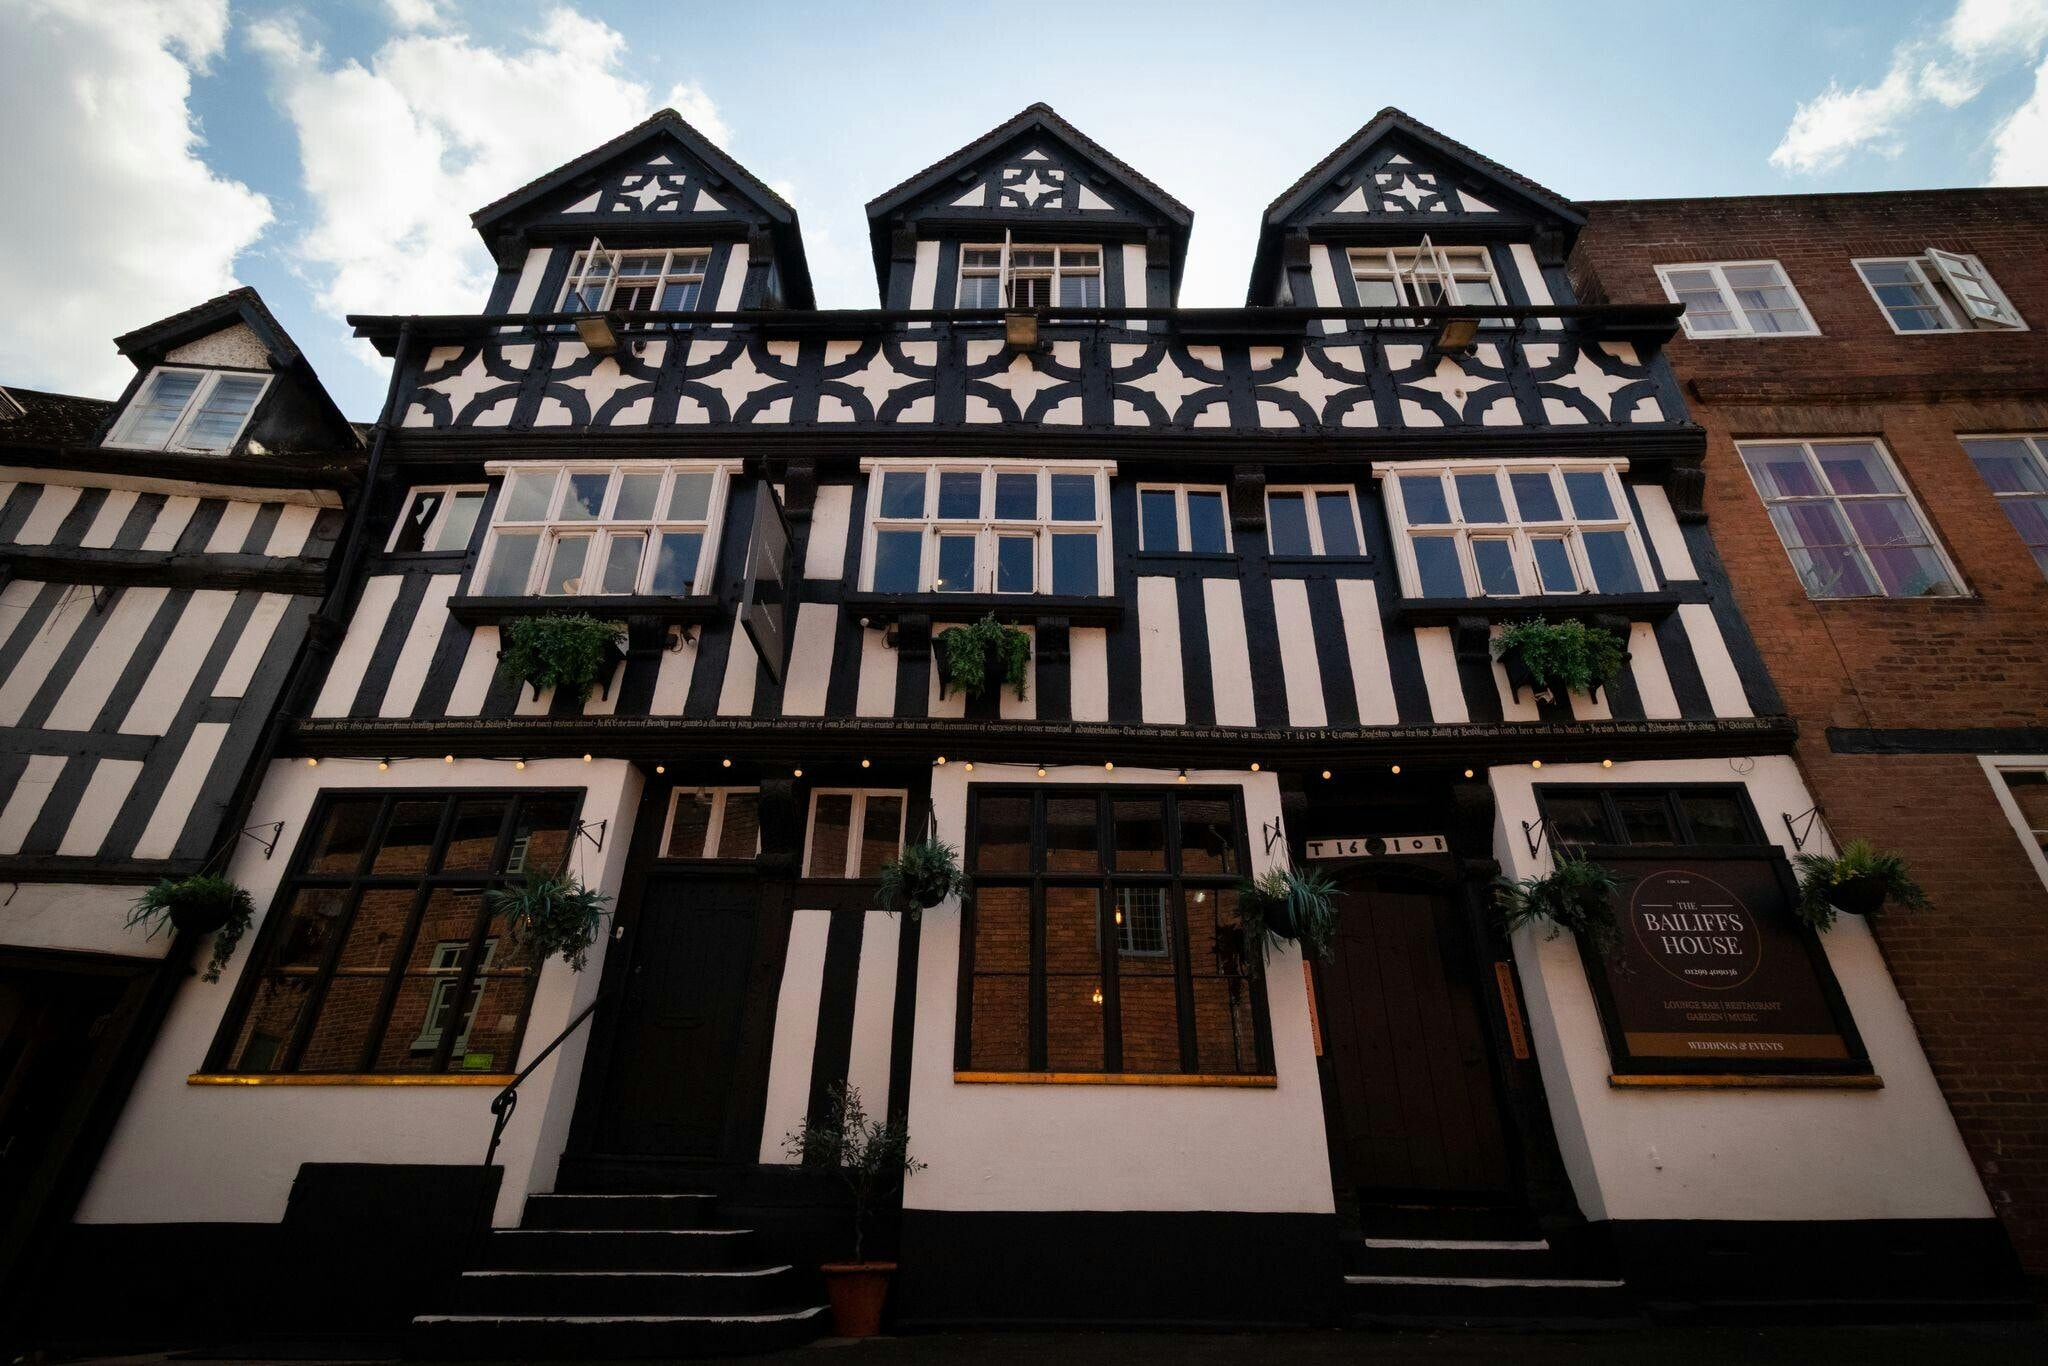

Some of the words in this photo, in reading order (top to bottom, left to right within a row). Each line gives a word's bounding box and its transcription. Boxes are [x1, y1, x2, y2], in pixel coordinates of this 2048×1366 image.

[1296, 731, 1315, 739] 1610
[1308, 842, 1323, 856] T
[1434, 837, 1443, 850] B
[1676, 901, 1698, 911] THE
[1642, 913, 1744, 931] BAILIFFS
[1661, 936, 1743, 955] HOUSE
[1684, 968, 1708, 976] 01299
[1663, 1000, 1698, 1010] LOUNGE
[1699, 1000, 1720, 1010] BAR
[1724, 1000, 1781, 1010] RESTAURANT
[1687, 1012, 1723, 1022] GARDEN
[1727, 1012, 1759, 1022] MUSIC
[1688, 1041, 1738, 1050] WEDDINGS
[1739, 1042, 1747, 1050] &
[1747, 1041, 1785, 1051] EVENTS
